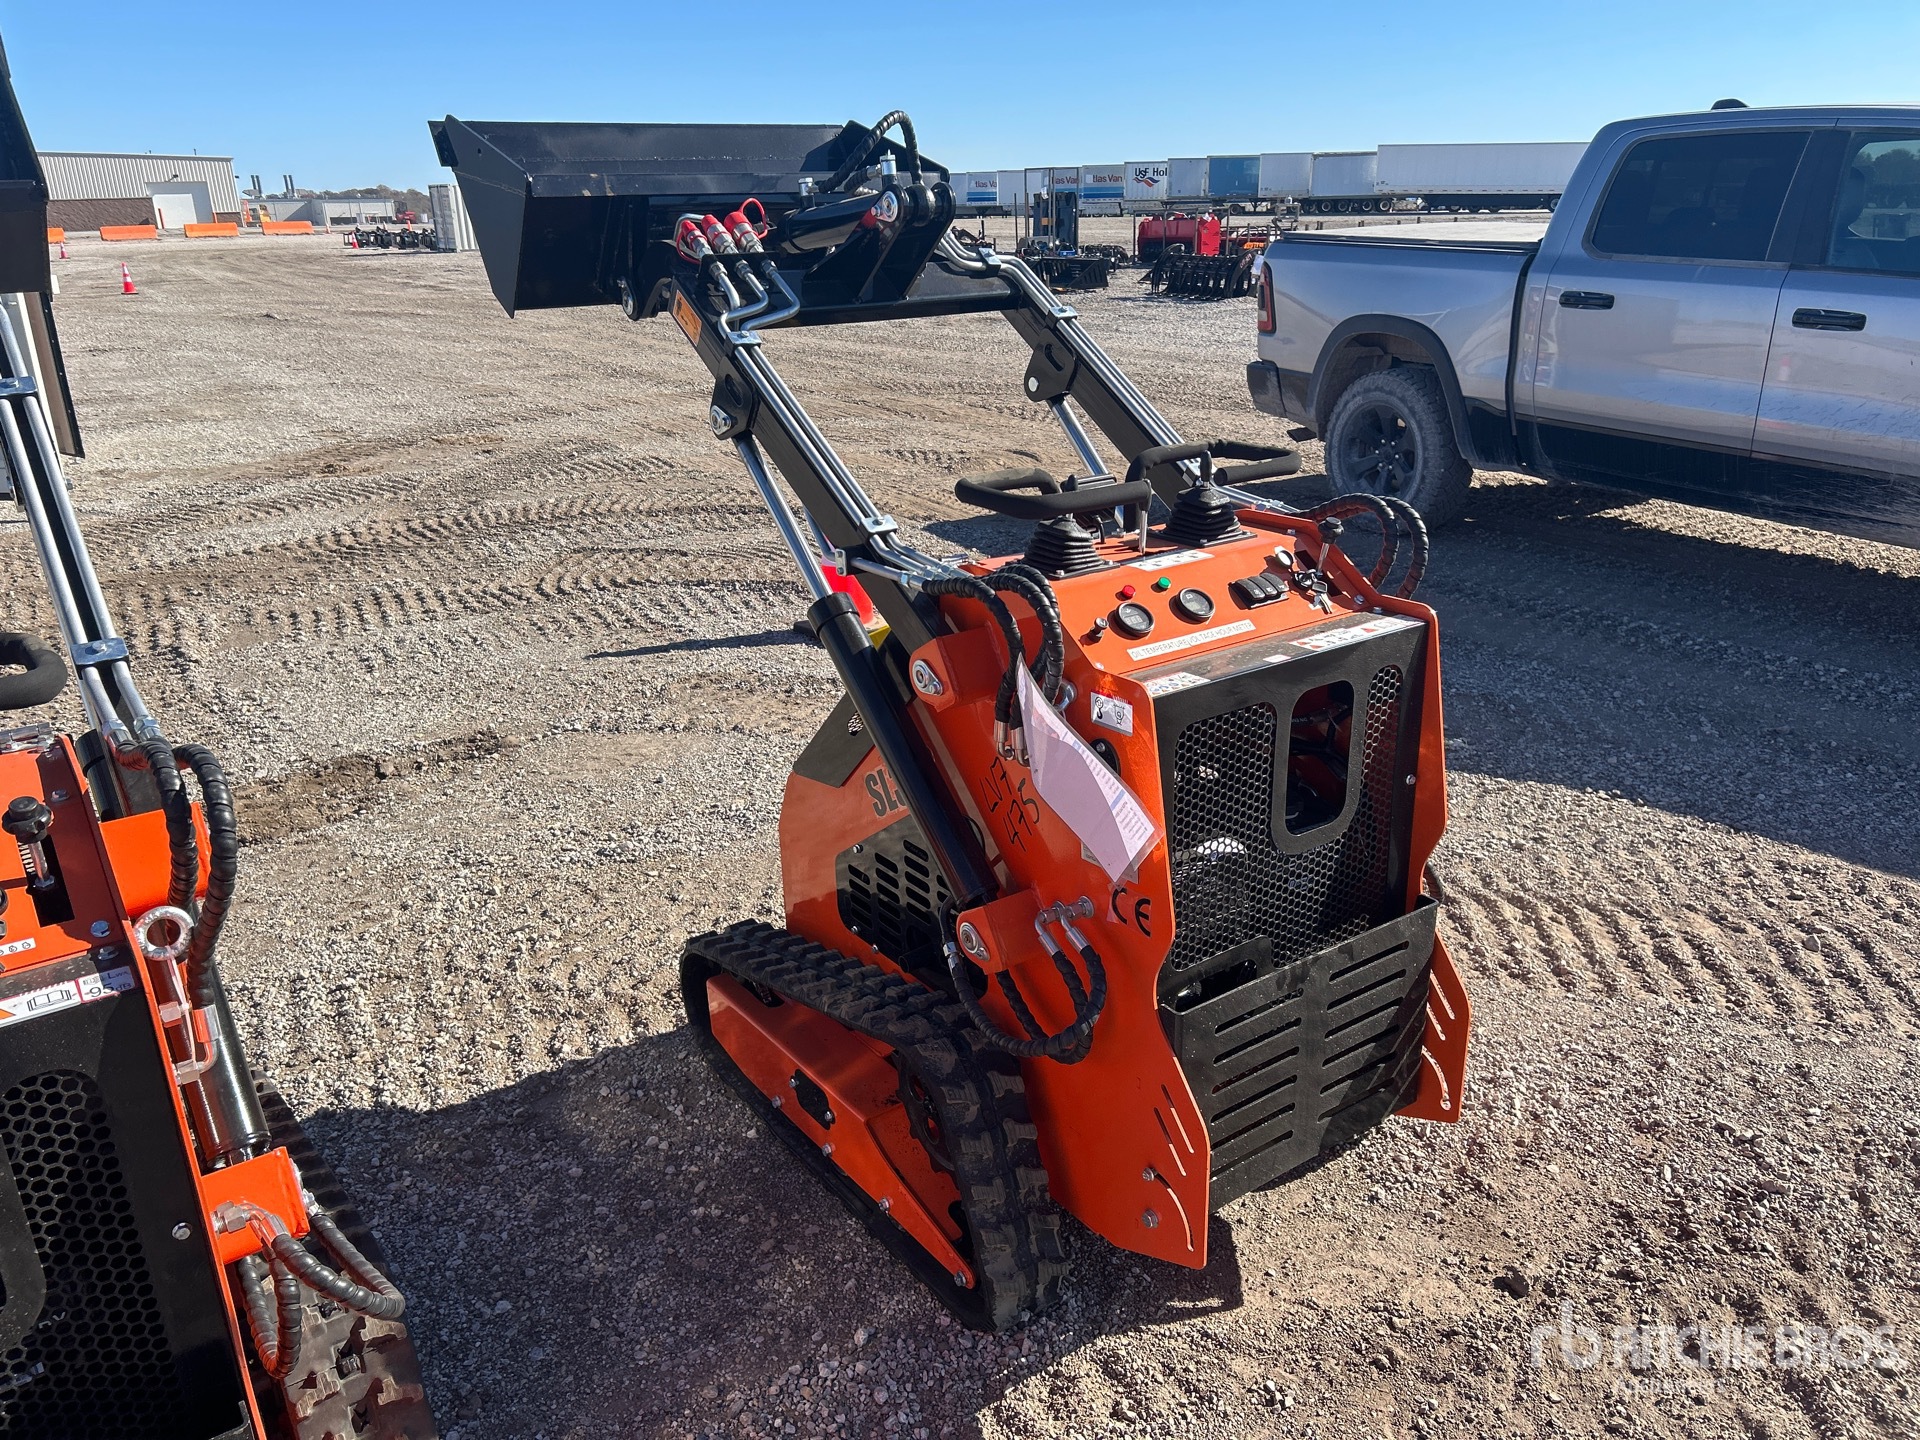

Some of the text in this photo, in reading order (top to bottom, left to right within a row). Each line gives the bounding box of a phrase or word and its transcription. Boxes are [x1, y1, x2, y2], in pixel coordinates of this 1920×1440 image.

[1107, 174, 1123, 183] Van
[1152, 167, 1168, 177] Hol
[1131, 649, 1145, 659] OIL
[1142, 638, 1188, 655] TEMPERATURE
[1231, 621, 1252, 632] METER
[864, 768, 907, 817] SL
[1002, 777, 1040, 852] 475
[1111, 887, 1152, 938] CE
